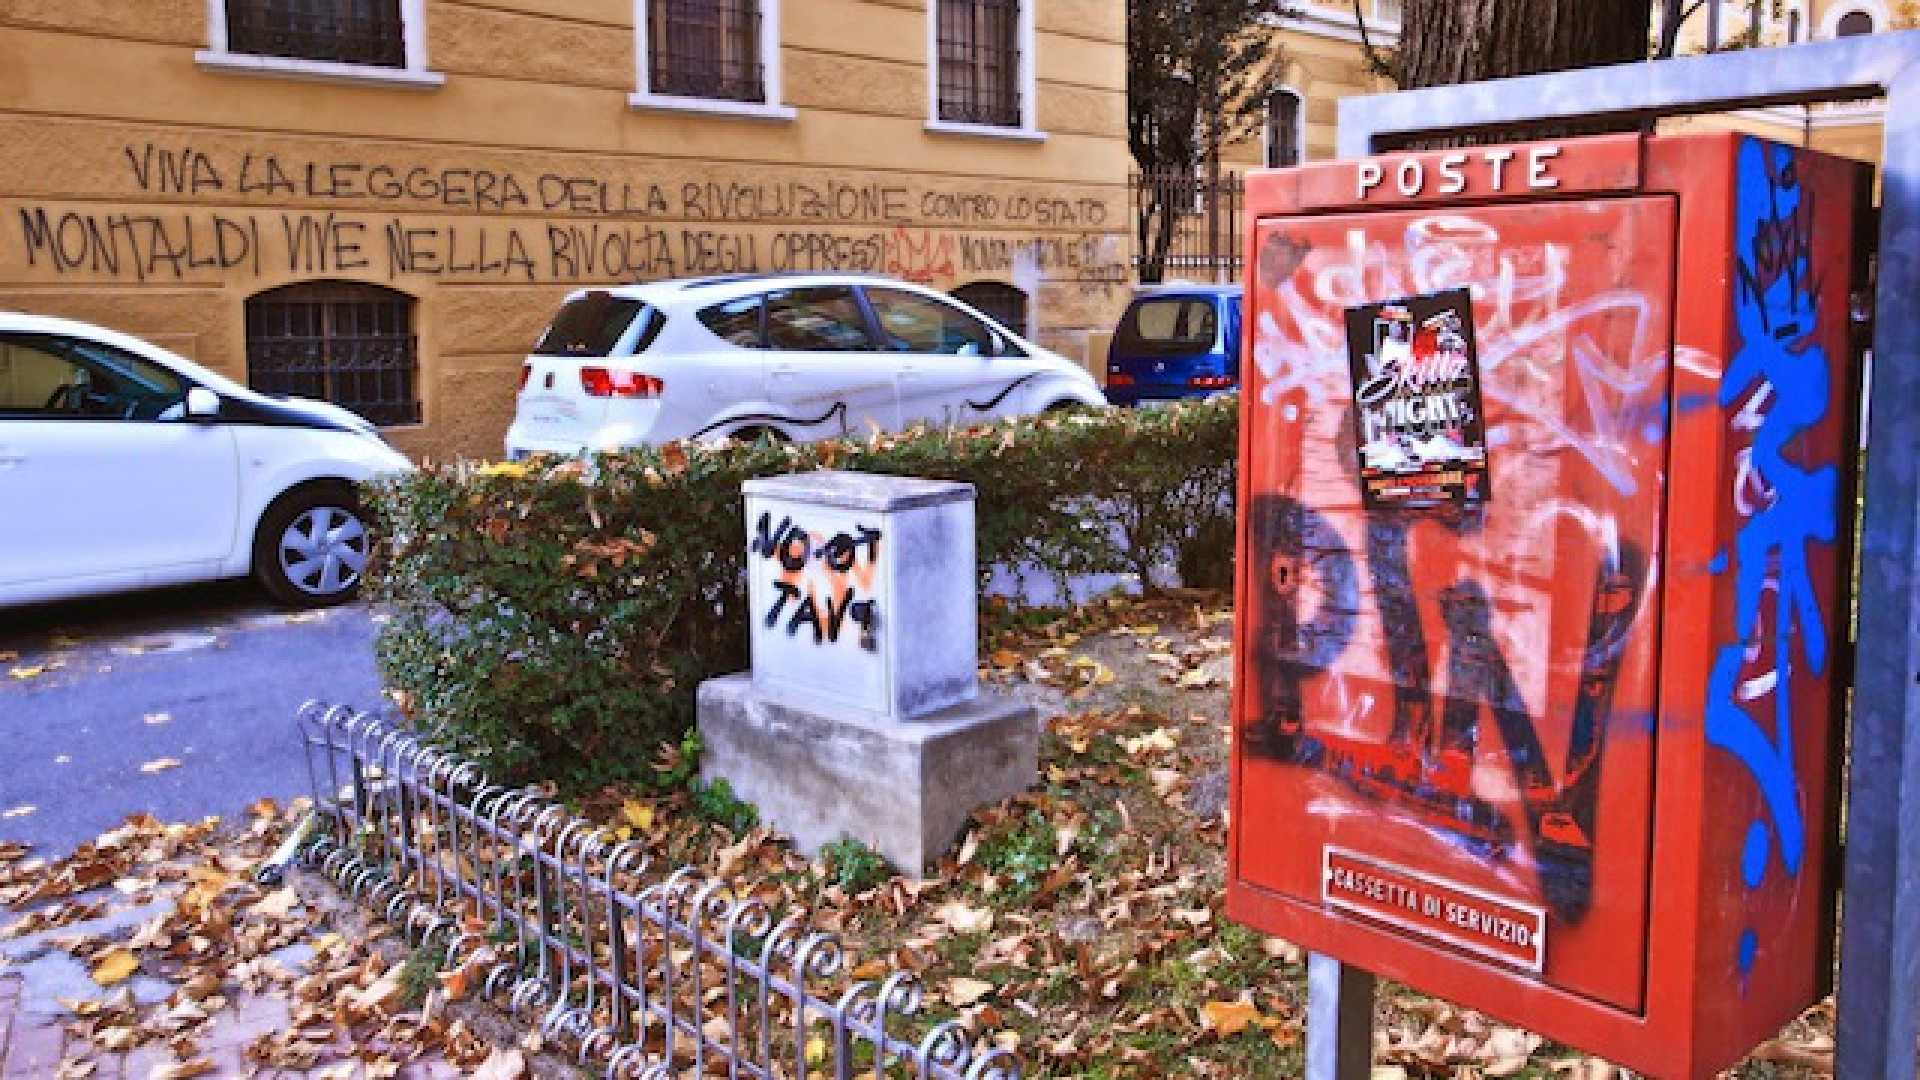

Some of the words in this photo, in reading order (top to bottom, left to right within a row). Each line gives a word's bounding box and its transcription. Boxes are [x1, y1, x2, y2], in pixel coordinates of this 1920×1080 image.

[125, 143, 223, 195] VIVA
[537, 173, 667, 216] DELLA
[921, 191, 1000, 223] CONTRO
[1356, 146, 1561, 200] POSTE
[19, 206, 260, 283] MONTALDI
[281, 212, 369, 273] VIVE
[387, 218, 534, 281] NELLA
[548, 222, 676, 279] RIVOLTA
[681, 230, 758, 274] DEGLI
[1334, 866, 1418, 911] CASSETTA
[1423, 893, 1441, 919] DI
[1445, 901, 1529, 947] SERVIZIO
